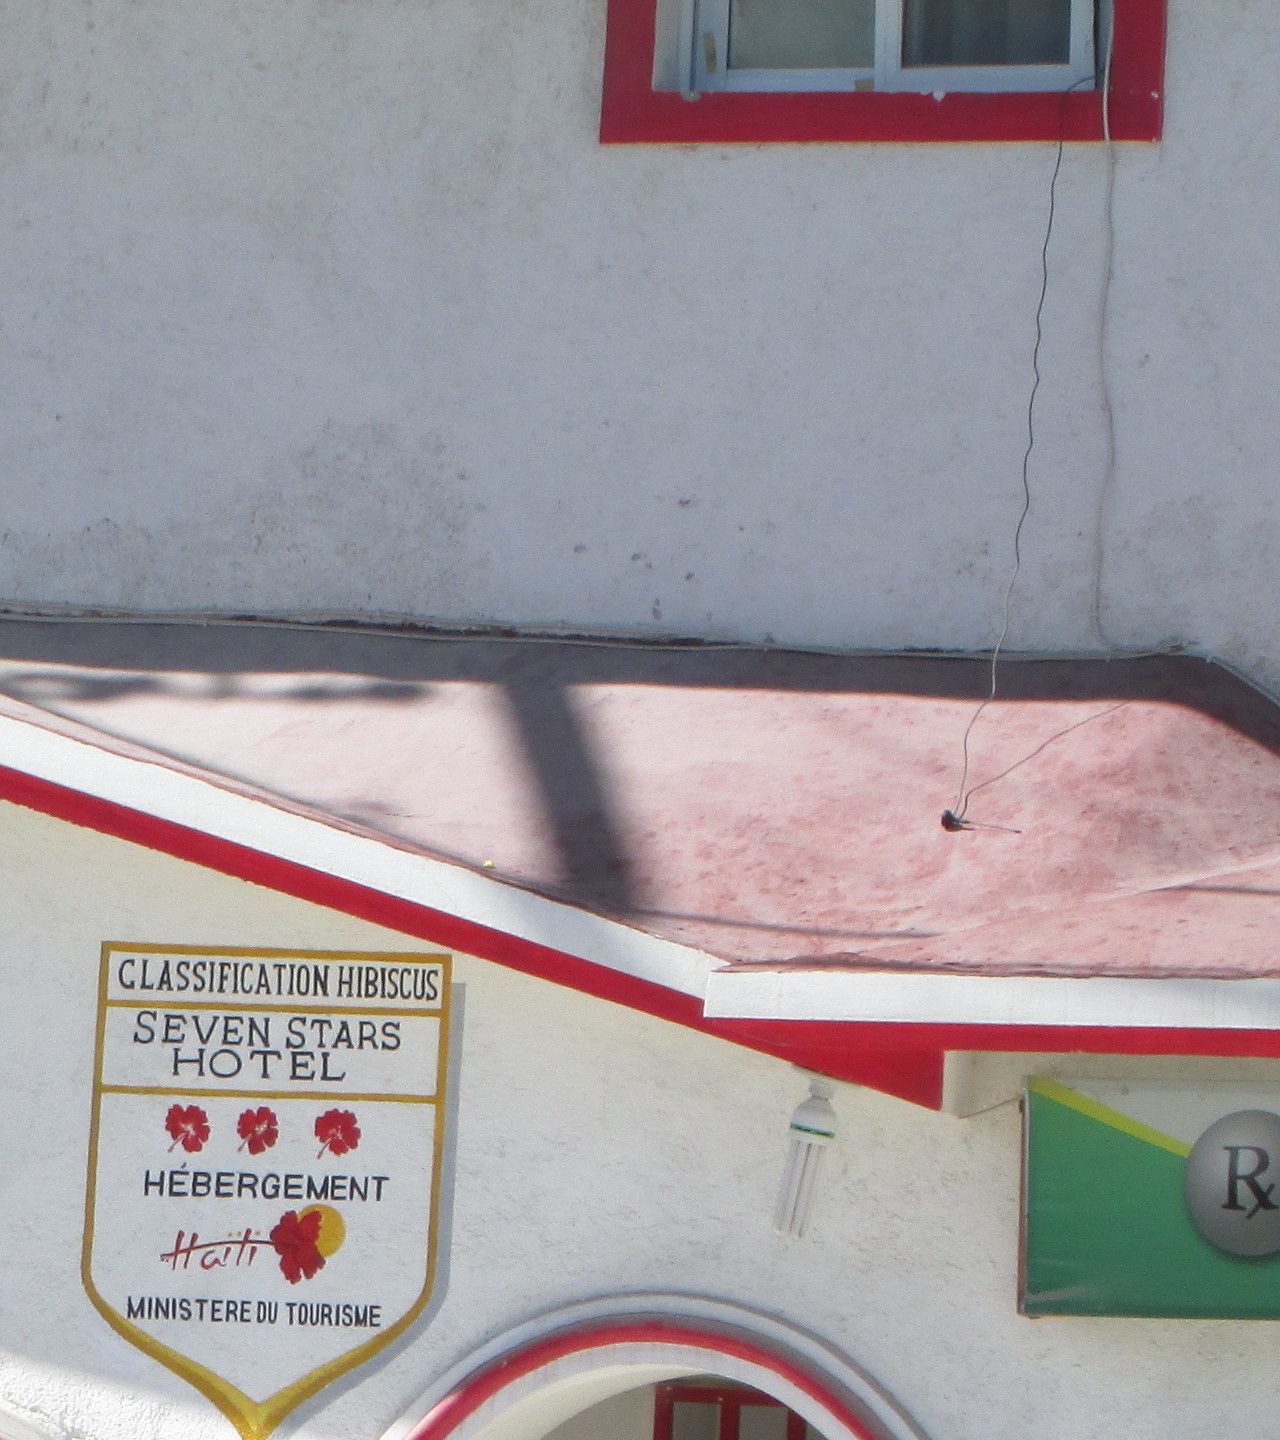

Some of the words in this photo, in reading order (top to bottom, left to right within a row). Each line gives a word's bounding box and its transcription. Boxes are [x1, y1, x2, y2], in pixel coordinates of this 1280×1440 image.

[118, 959, 330, 997] CLASSIFICATION
[336, 965, 438, 1001] HIBISCUS
[133, 1010, 271, 1048] SEVEN
[285, 1016, 402, 1051] STARS
[171, 1048, 346, 1082] HOTEL
[143, 1162, 390, 1202] HÉBERGEMENT
[257, 1301, 279, 1325] DU
[287, 1302, 382, 1328] TOURISME
